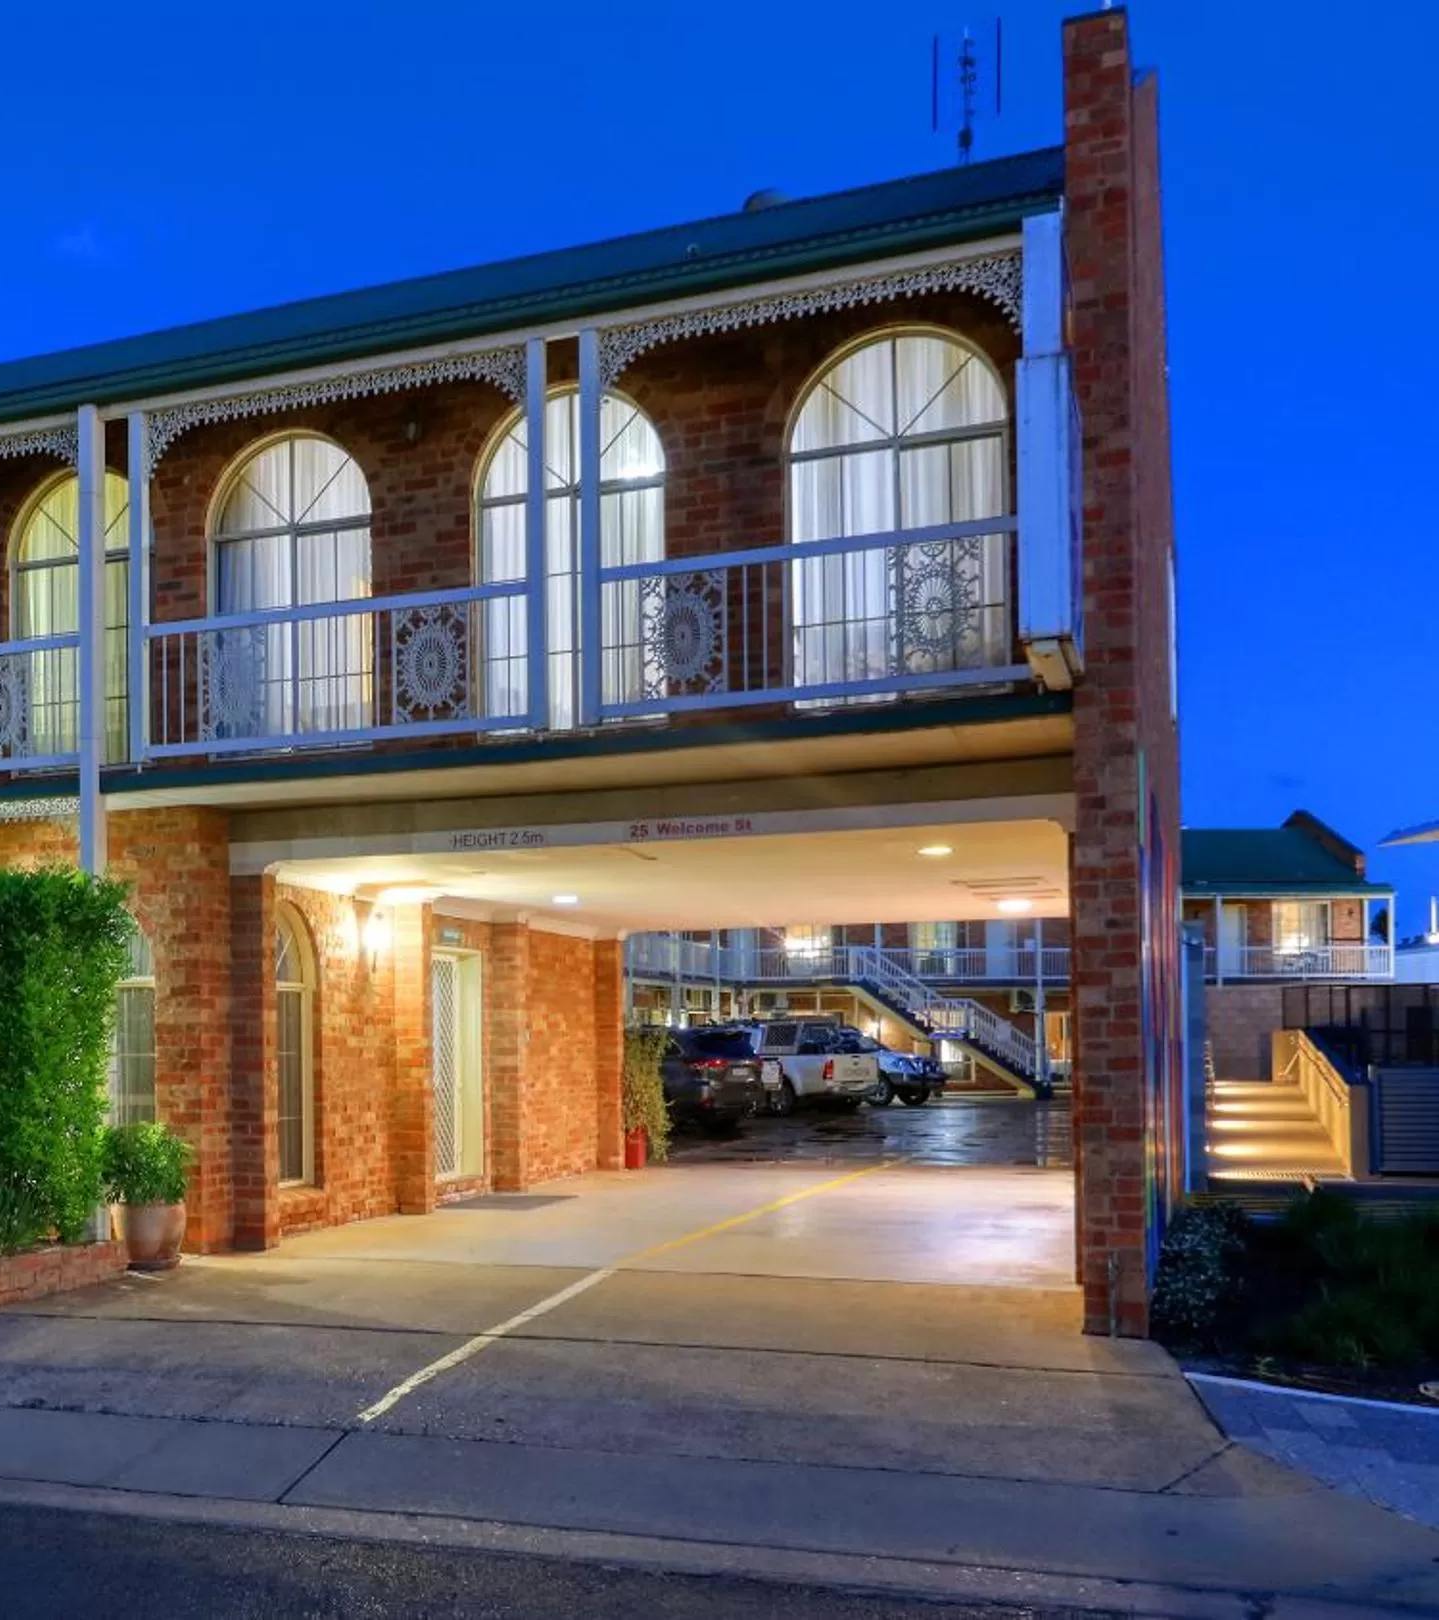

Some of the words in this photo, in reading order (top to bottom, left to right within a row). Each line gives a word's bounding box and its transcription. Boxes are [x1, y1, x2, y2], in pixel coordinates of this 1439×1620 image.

[629, 824, 649, 838] 25
[656, 821, 729, 835] Welcome
[451, 832, 507, 848] HEIGHT
